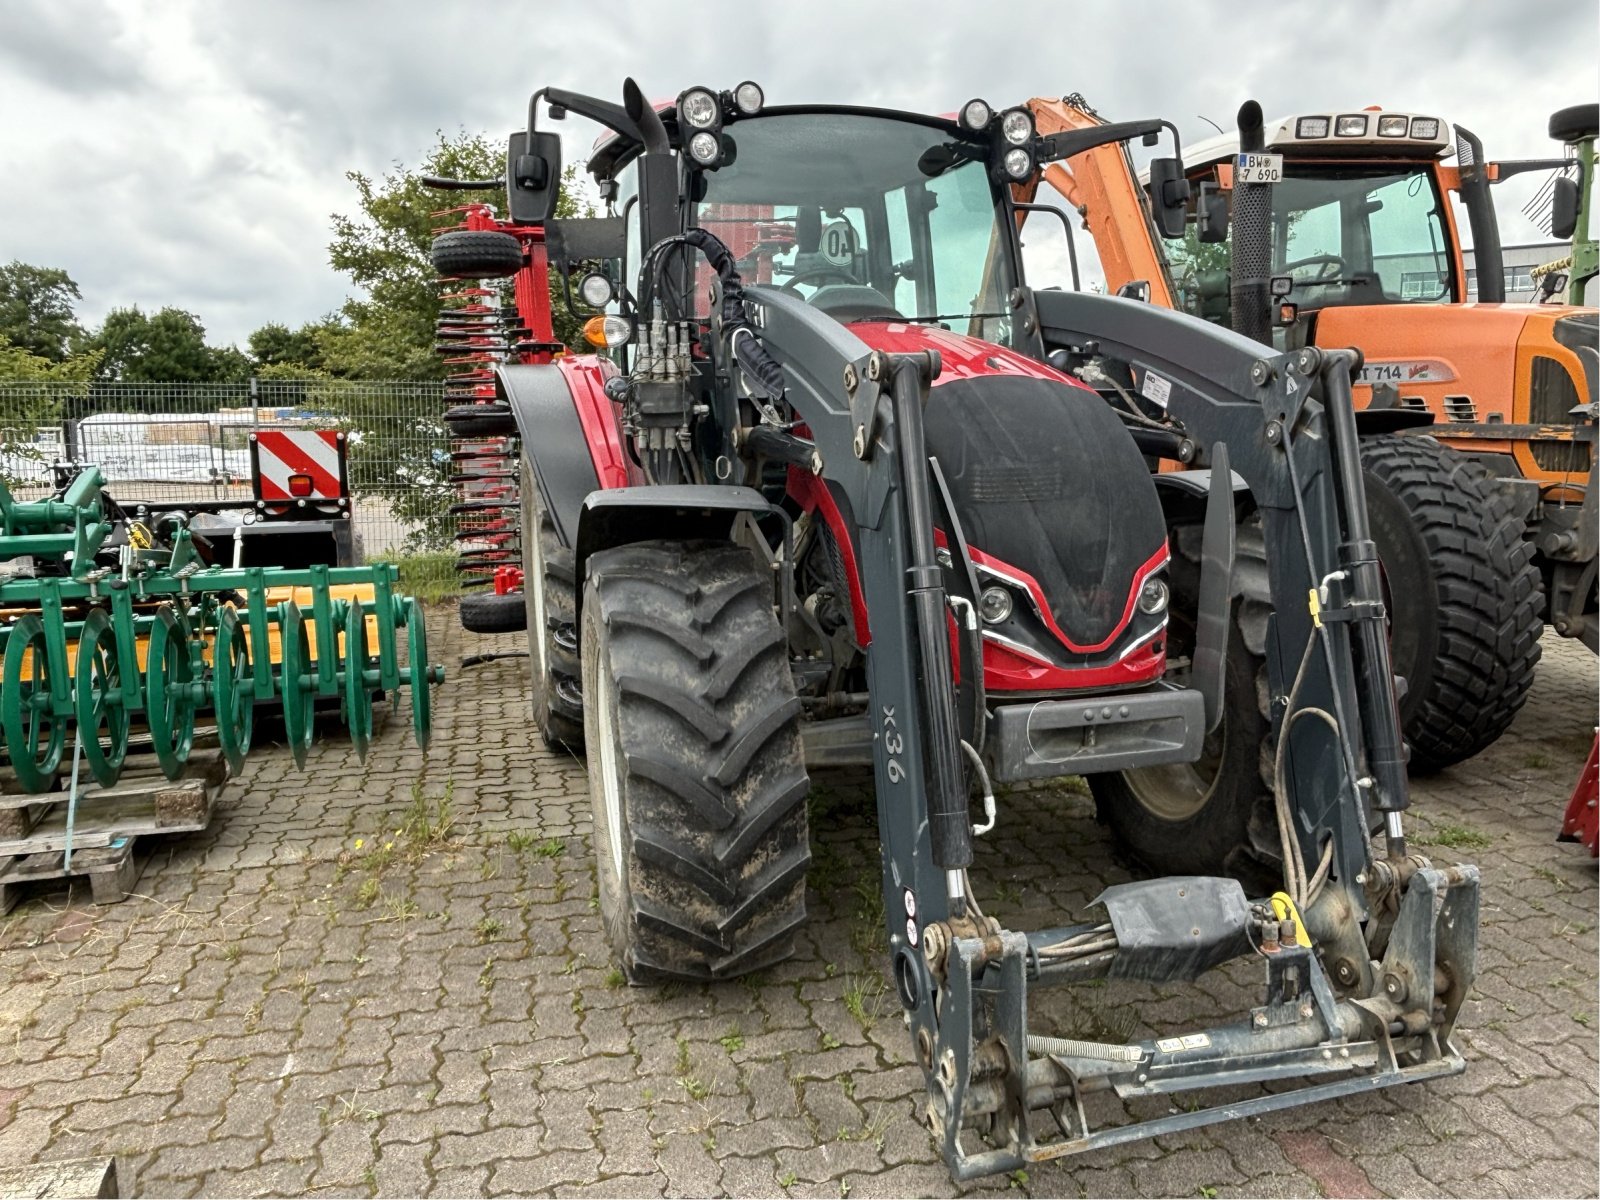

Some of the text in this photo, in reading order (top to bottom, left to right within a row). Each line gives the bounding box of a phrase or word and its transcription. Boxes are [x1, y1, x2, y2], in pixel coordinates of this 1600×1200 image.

[1248, 156, 1263, 168] BW
[1243, 168, 1278, 181] 7 690
[1374, 366, 1402, 380] 714
